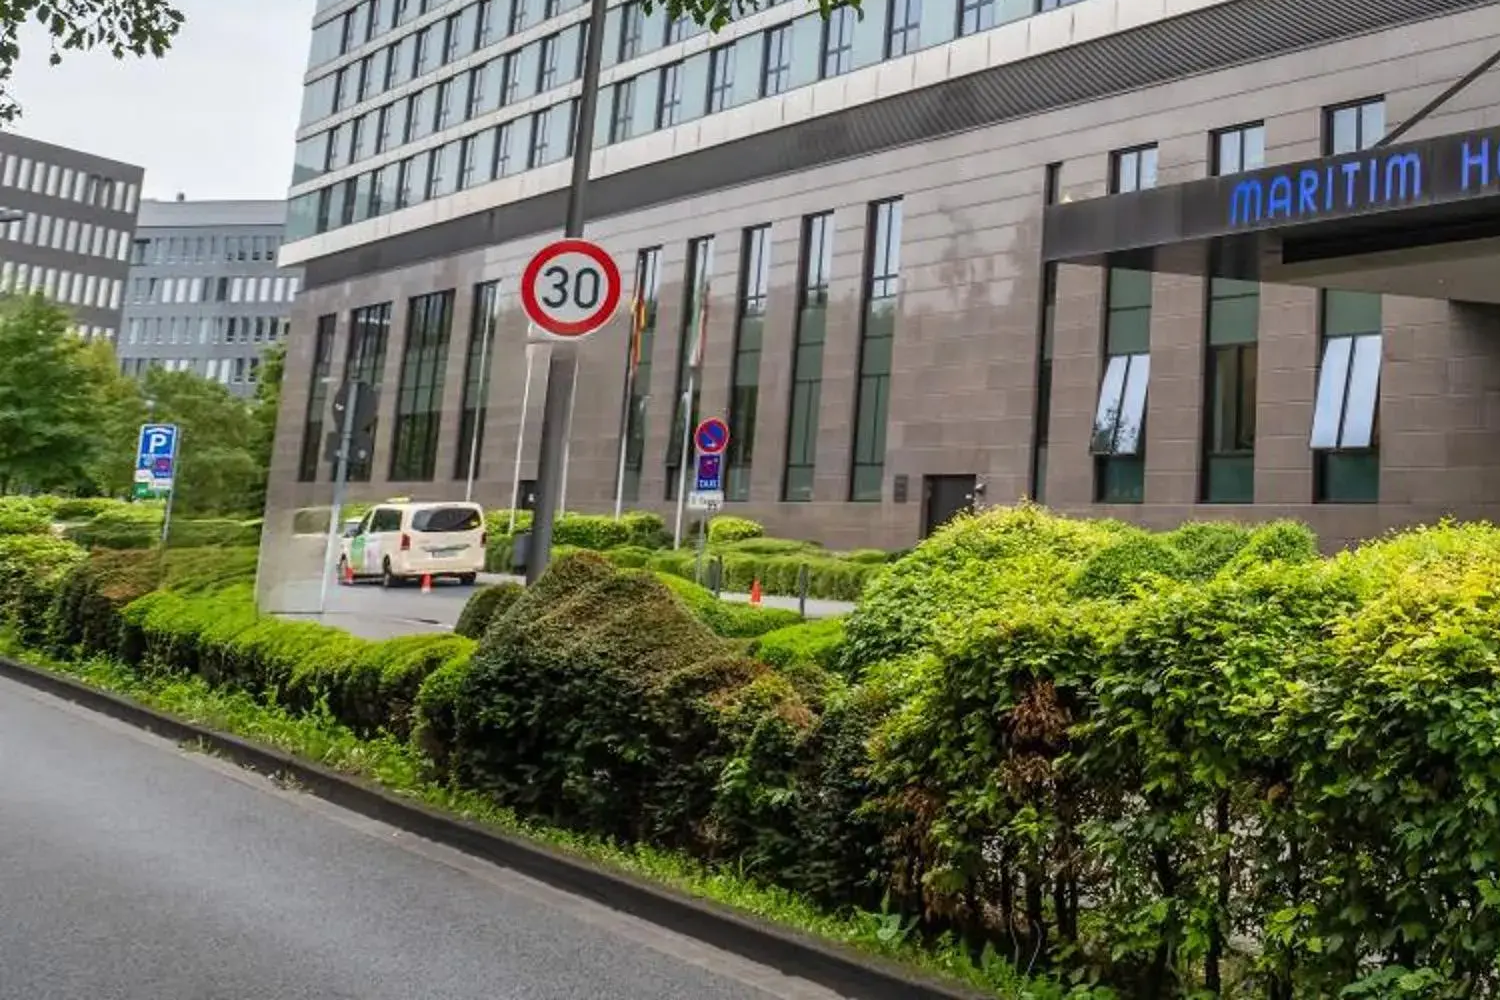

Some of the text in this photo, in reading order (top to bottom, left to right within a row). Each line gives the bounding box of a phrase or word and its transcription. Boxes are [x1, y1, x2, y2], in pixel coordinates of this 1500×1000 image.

[1230, 153, 1421, 224] MARITIM
[542, 266, 600, 309] 30
[149, 433, 167, 453] P
